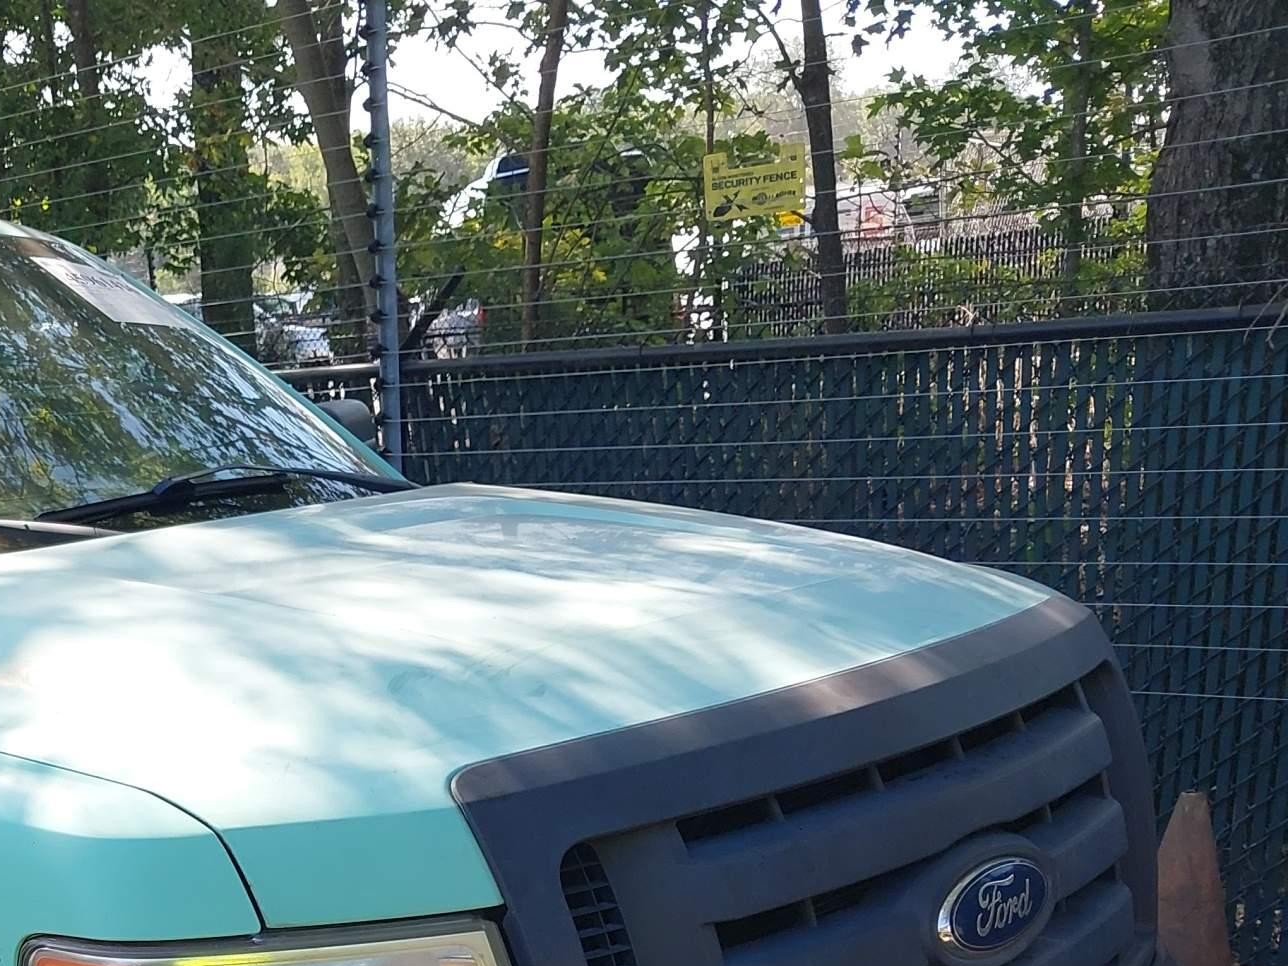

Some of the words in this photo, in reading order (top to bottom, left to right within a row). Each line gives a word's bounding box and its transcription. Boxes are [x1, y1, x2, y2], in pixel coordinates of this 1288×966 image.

[711, 175, 762, 191] SECURITY
[762, 170, 798, 184] FENCE
[976, 873, 1033, 937] Ford
